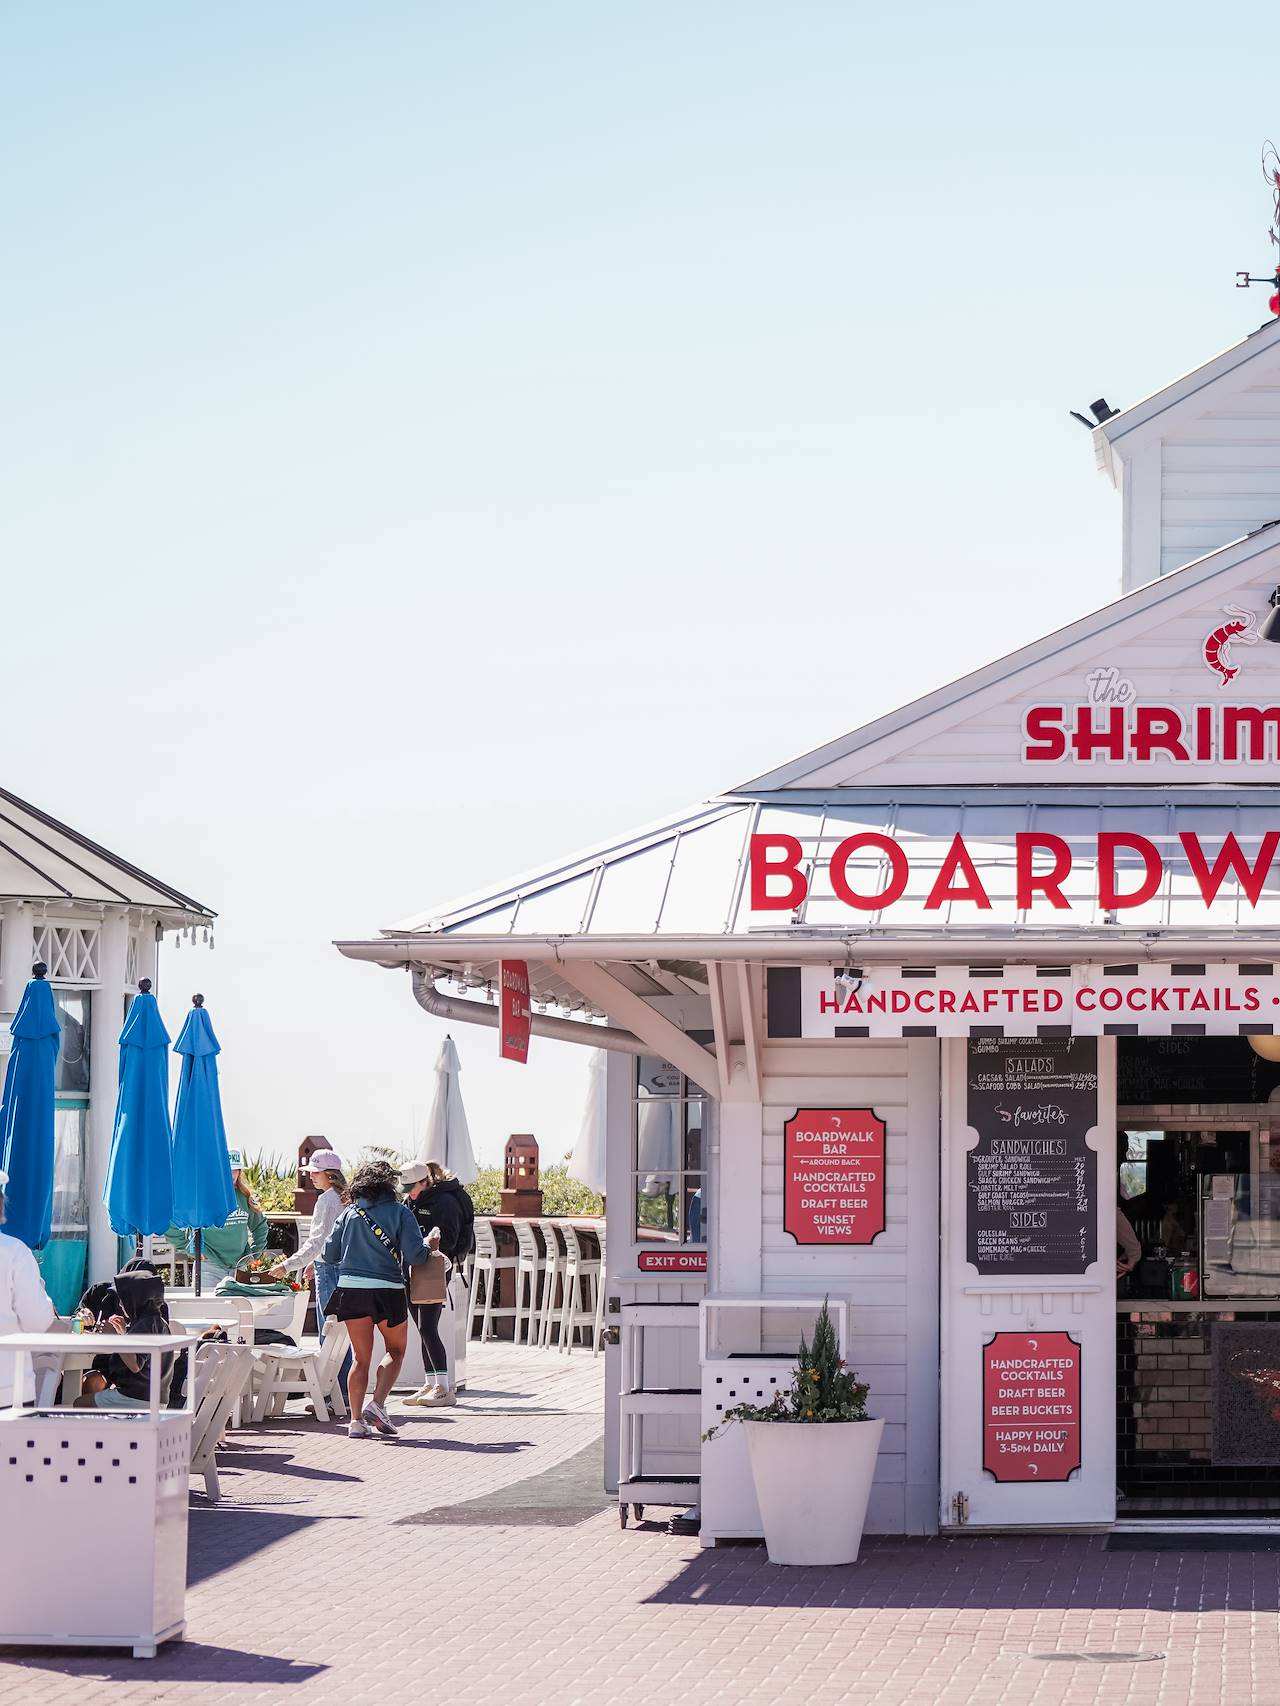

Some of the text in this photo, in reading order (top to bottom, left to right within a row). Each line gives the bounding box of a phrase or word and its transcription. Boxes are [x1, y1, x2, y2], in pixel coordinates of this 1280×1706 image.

[1089, 671, 1132, 703] the
[819, 989, 1064, 1014] HANDCRAFTED
[1075, 988, 1261, 1012] COCKTAILS
[977, 1045, 999, 1054] GUMBO
[1007, 1060, 1053, 1073] SALADS
[1013, 1104, 1070, 1127] favorites
[796, 1132, 874, 1142] BOARDWALK
[823, 1144, 847, 1154] BAR
[992, 1140, 1064, 1155] SANDWICHES
[793, 1172, 876, 1182] HANDCRAFTED
[803, 1183, 866, 1192] COCKTAILS
[801, 1199, 868, 1208] DRAFT BEER
[813, 1215, 855, 1224] SUNSET
[1012, 1212, 1046, 1228] SIDES
[817, 1226, 851, 1235] VIEWS
[646, 1257, 708, 1266] EXIT ONL
[991, 1359, 1074, 1369] HANDCRAFTED
[1001, 1371, 1063, 1381] COCKTAILS
[999, 1388, 1065, 1398] DRAFT BEER
[992, 1405, 1073, 1416] BEER BUCKETS
[996, 1430, 1068, 1441] HAPPY HOUR
[1000, 1443, 1064, 1453] 3-5PM DAILY
